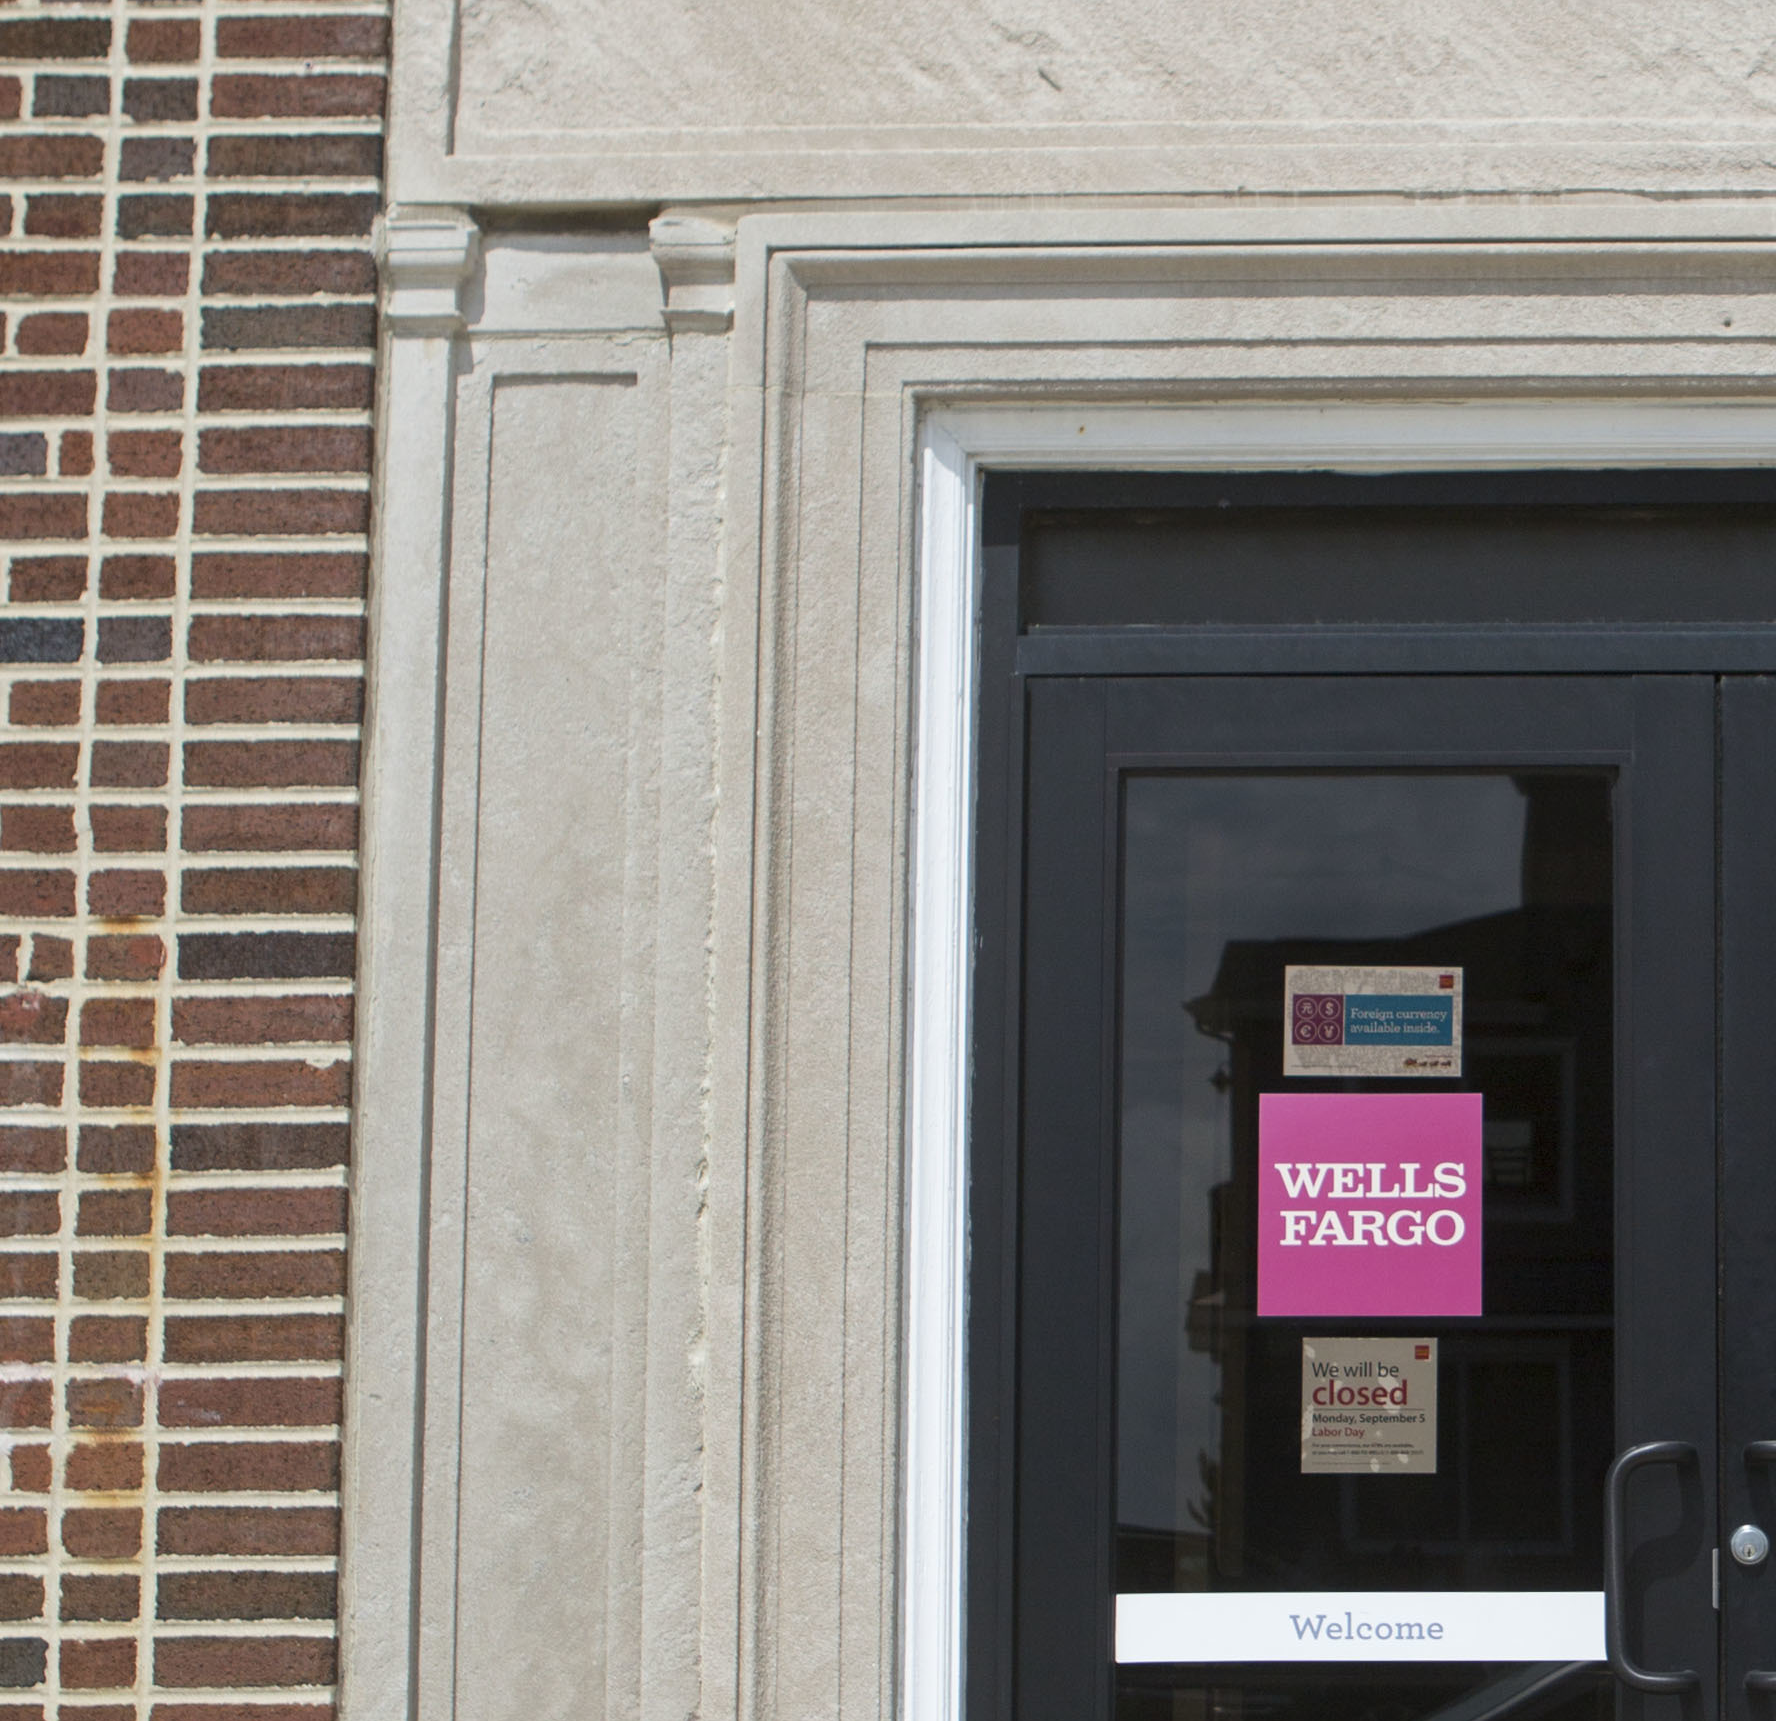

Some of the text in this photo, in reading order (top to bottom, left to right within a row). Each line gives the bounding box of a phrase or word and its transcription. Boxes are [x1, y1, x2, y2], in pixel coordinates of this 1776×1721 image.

[1351, 1008, 1447, 1021] Foreign currency
[1351, 1021, 1440, 1033] available inside.
[1274, 1163, 1466, 1198] WELLS
[1280, 1210, 1465, 1246] FARGO
[1312, 1362, 1399, 1377] We will be
[1313, 1379, 1407, 1405] closed
[1313, 1414, 1425, 1425] Monday, September 5
[1312, 1427, 1365, 1439] Labor Day
[1289, 1612, 1443, 1640] Welcome
